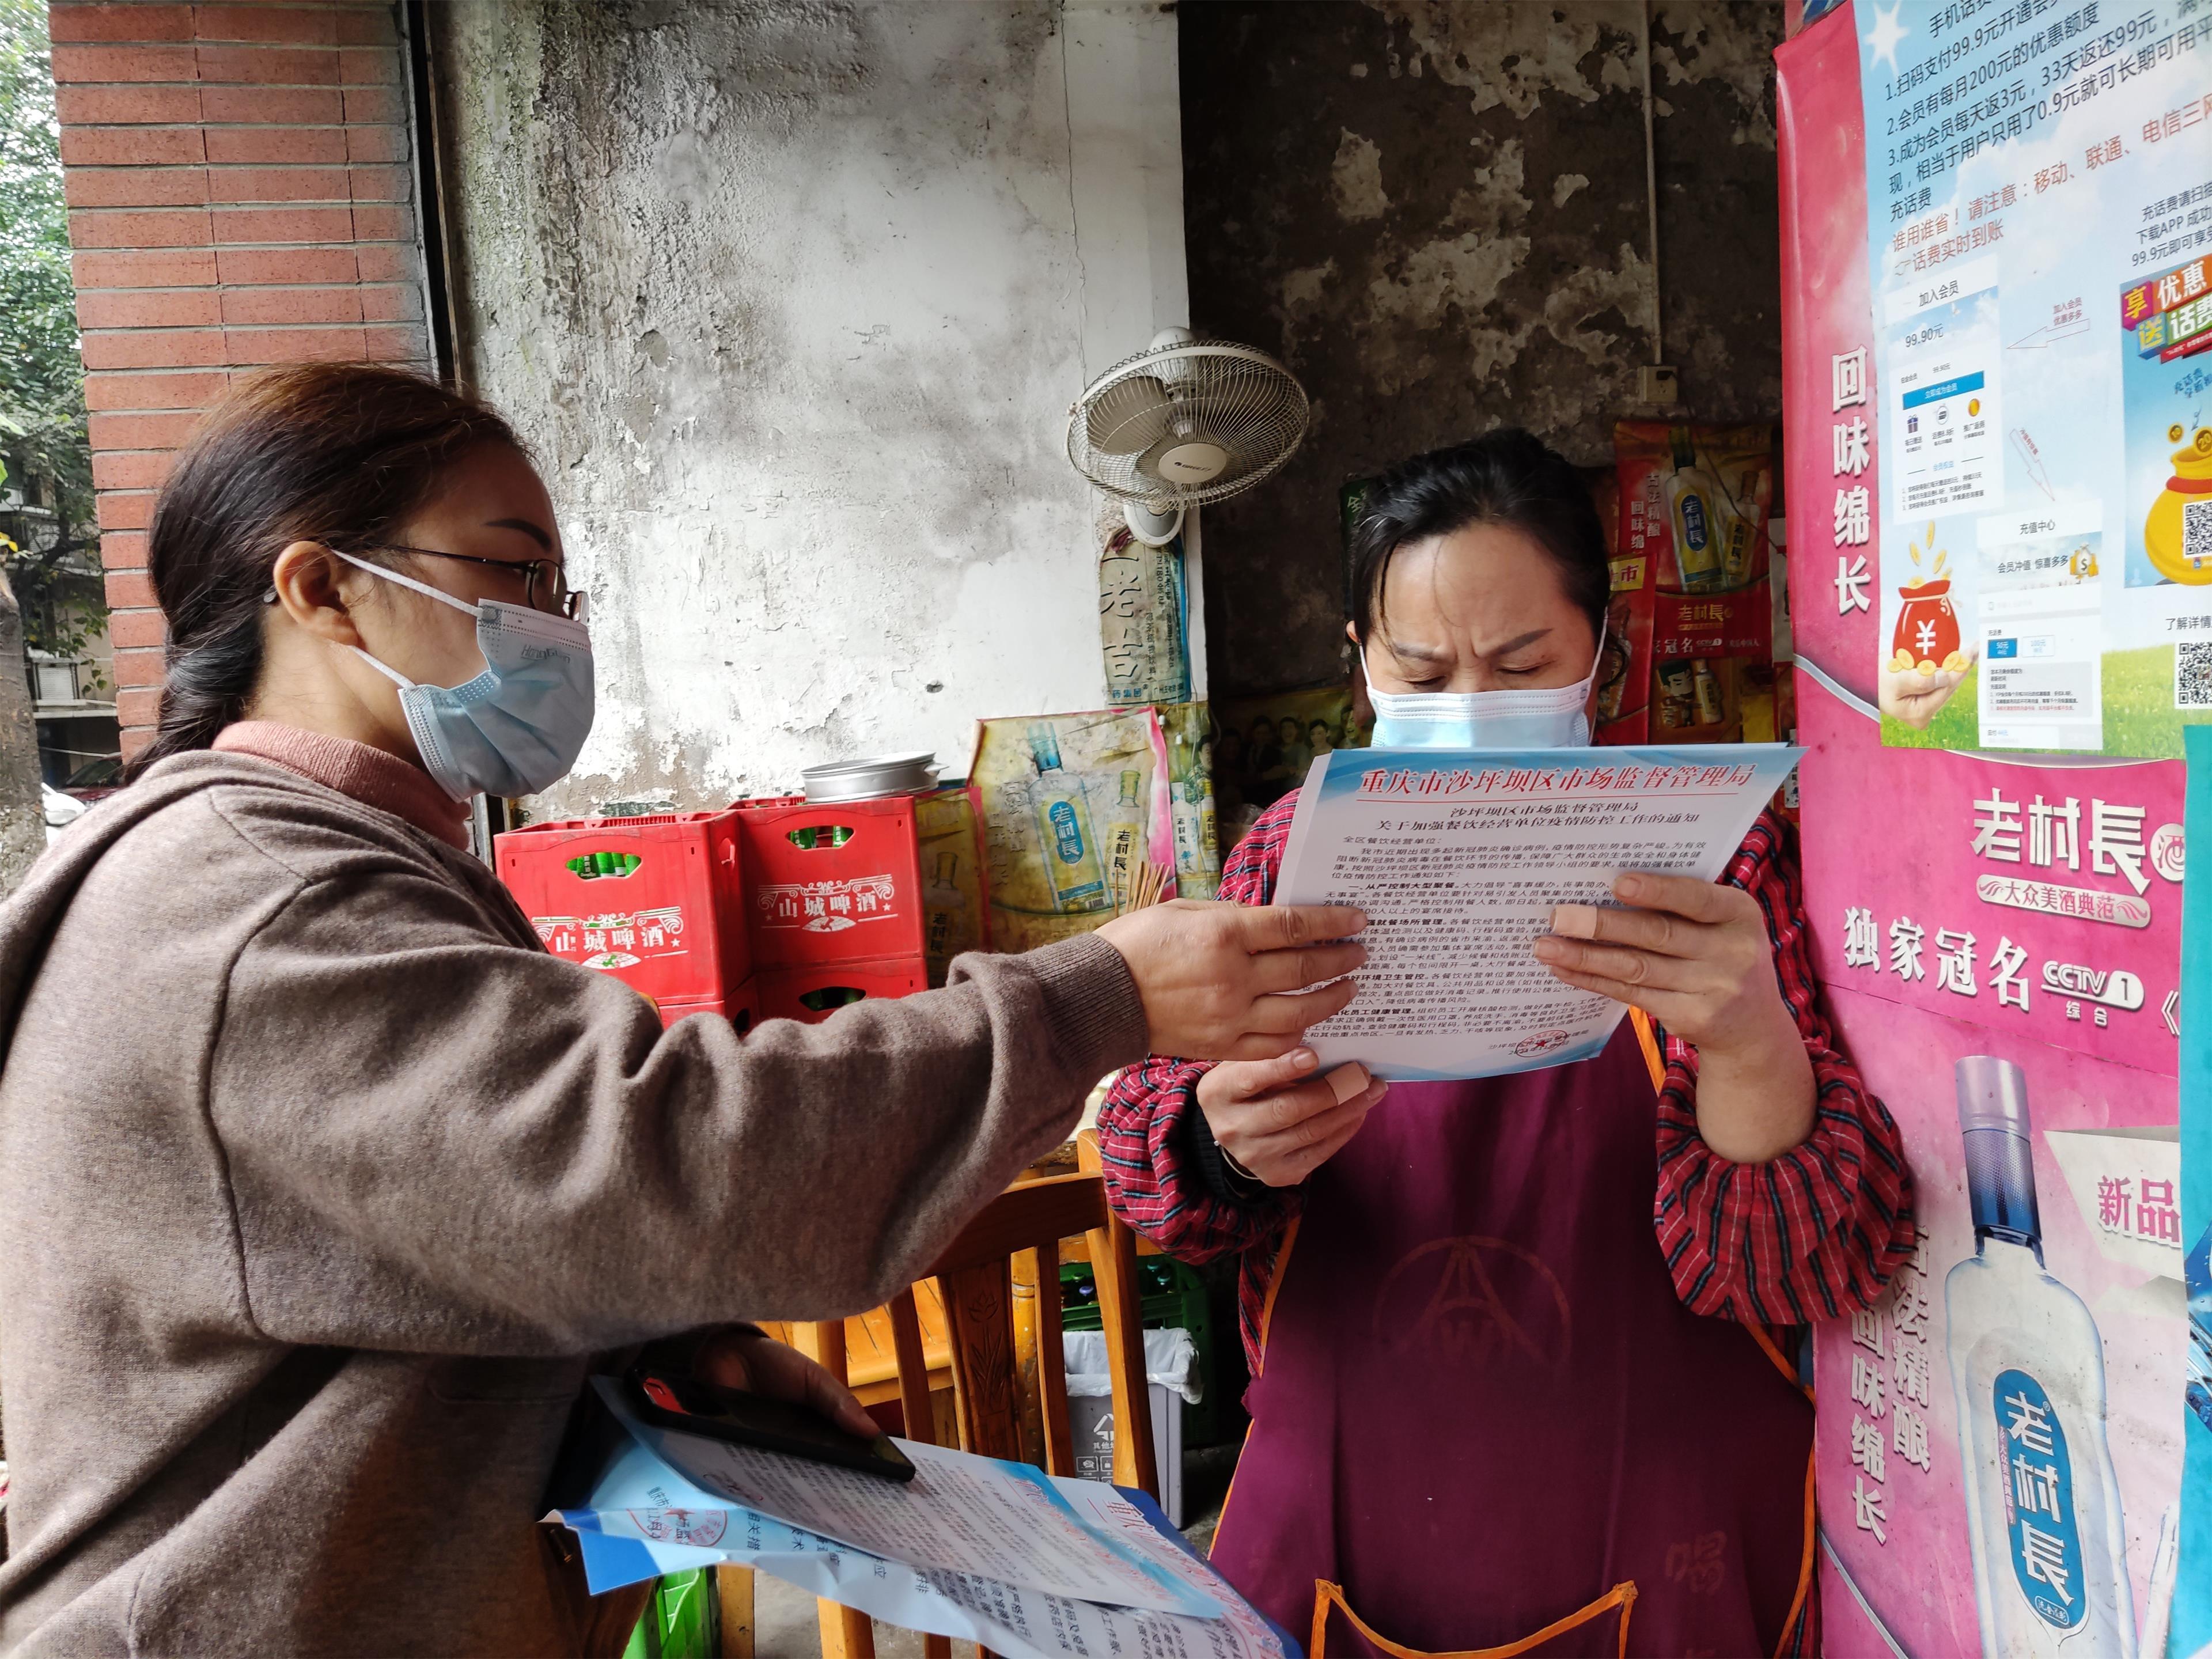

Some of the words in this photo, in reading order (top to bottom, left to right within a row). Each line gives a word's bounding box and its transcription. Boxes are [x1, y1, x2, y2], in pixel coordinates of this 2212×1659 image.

[1890, 187, 1931, 222] 充话费
[1913, 218, 2003, 272] 话费实时到账
[1919, 280, 1959, 307] 加入会员
[1906, 323, 1944, 348] 99.90元
[1832, 345, 1871, 616] 回味绵长
[1630, 500, 1646, 553] 回味绵
[1684, 499, 1705, 544] 老村長
[2020, 519, 2055, 535] 充值中心
[1677, 603, 1724, 623] 老村長
[2165, 615, 2212, 631] 了解详情
[1357, 763, 1758, 795] 重庆市沙坪坝区市场监督管理局
[1376, 813, 1700, 831] 关于加强餐饮经营单位疫情防控工作的通知
[1450, 801, 1639, 818] 沙坪坝区市场监督管理局
[1054, 806, 1081, 857] 老村長
[1969, 787, 2151, 895] 老村長
[1113, 829, 1131, 871] 老村長
[779, 891, 877, 918] 山城啤酒
[2005, 880, 2115, 920] 大众美酒典范
[555, 924, 664, 953] 山城啤酒
[1843, 906, 2030, 1013] 独家冠名
[2066, 1001, 2108, 1027] 综合
[2097, 1175, 2182, 1245] 新品
[2004, 1389, 2074, 1607] 老村長
